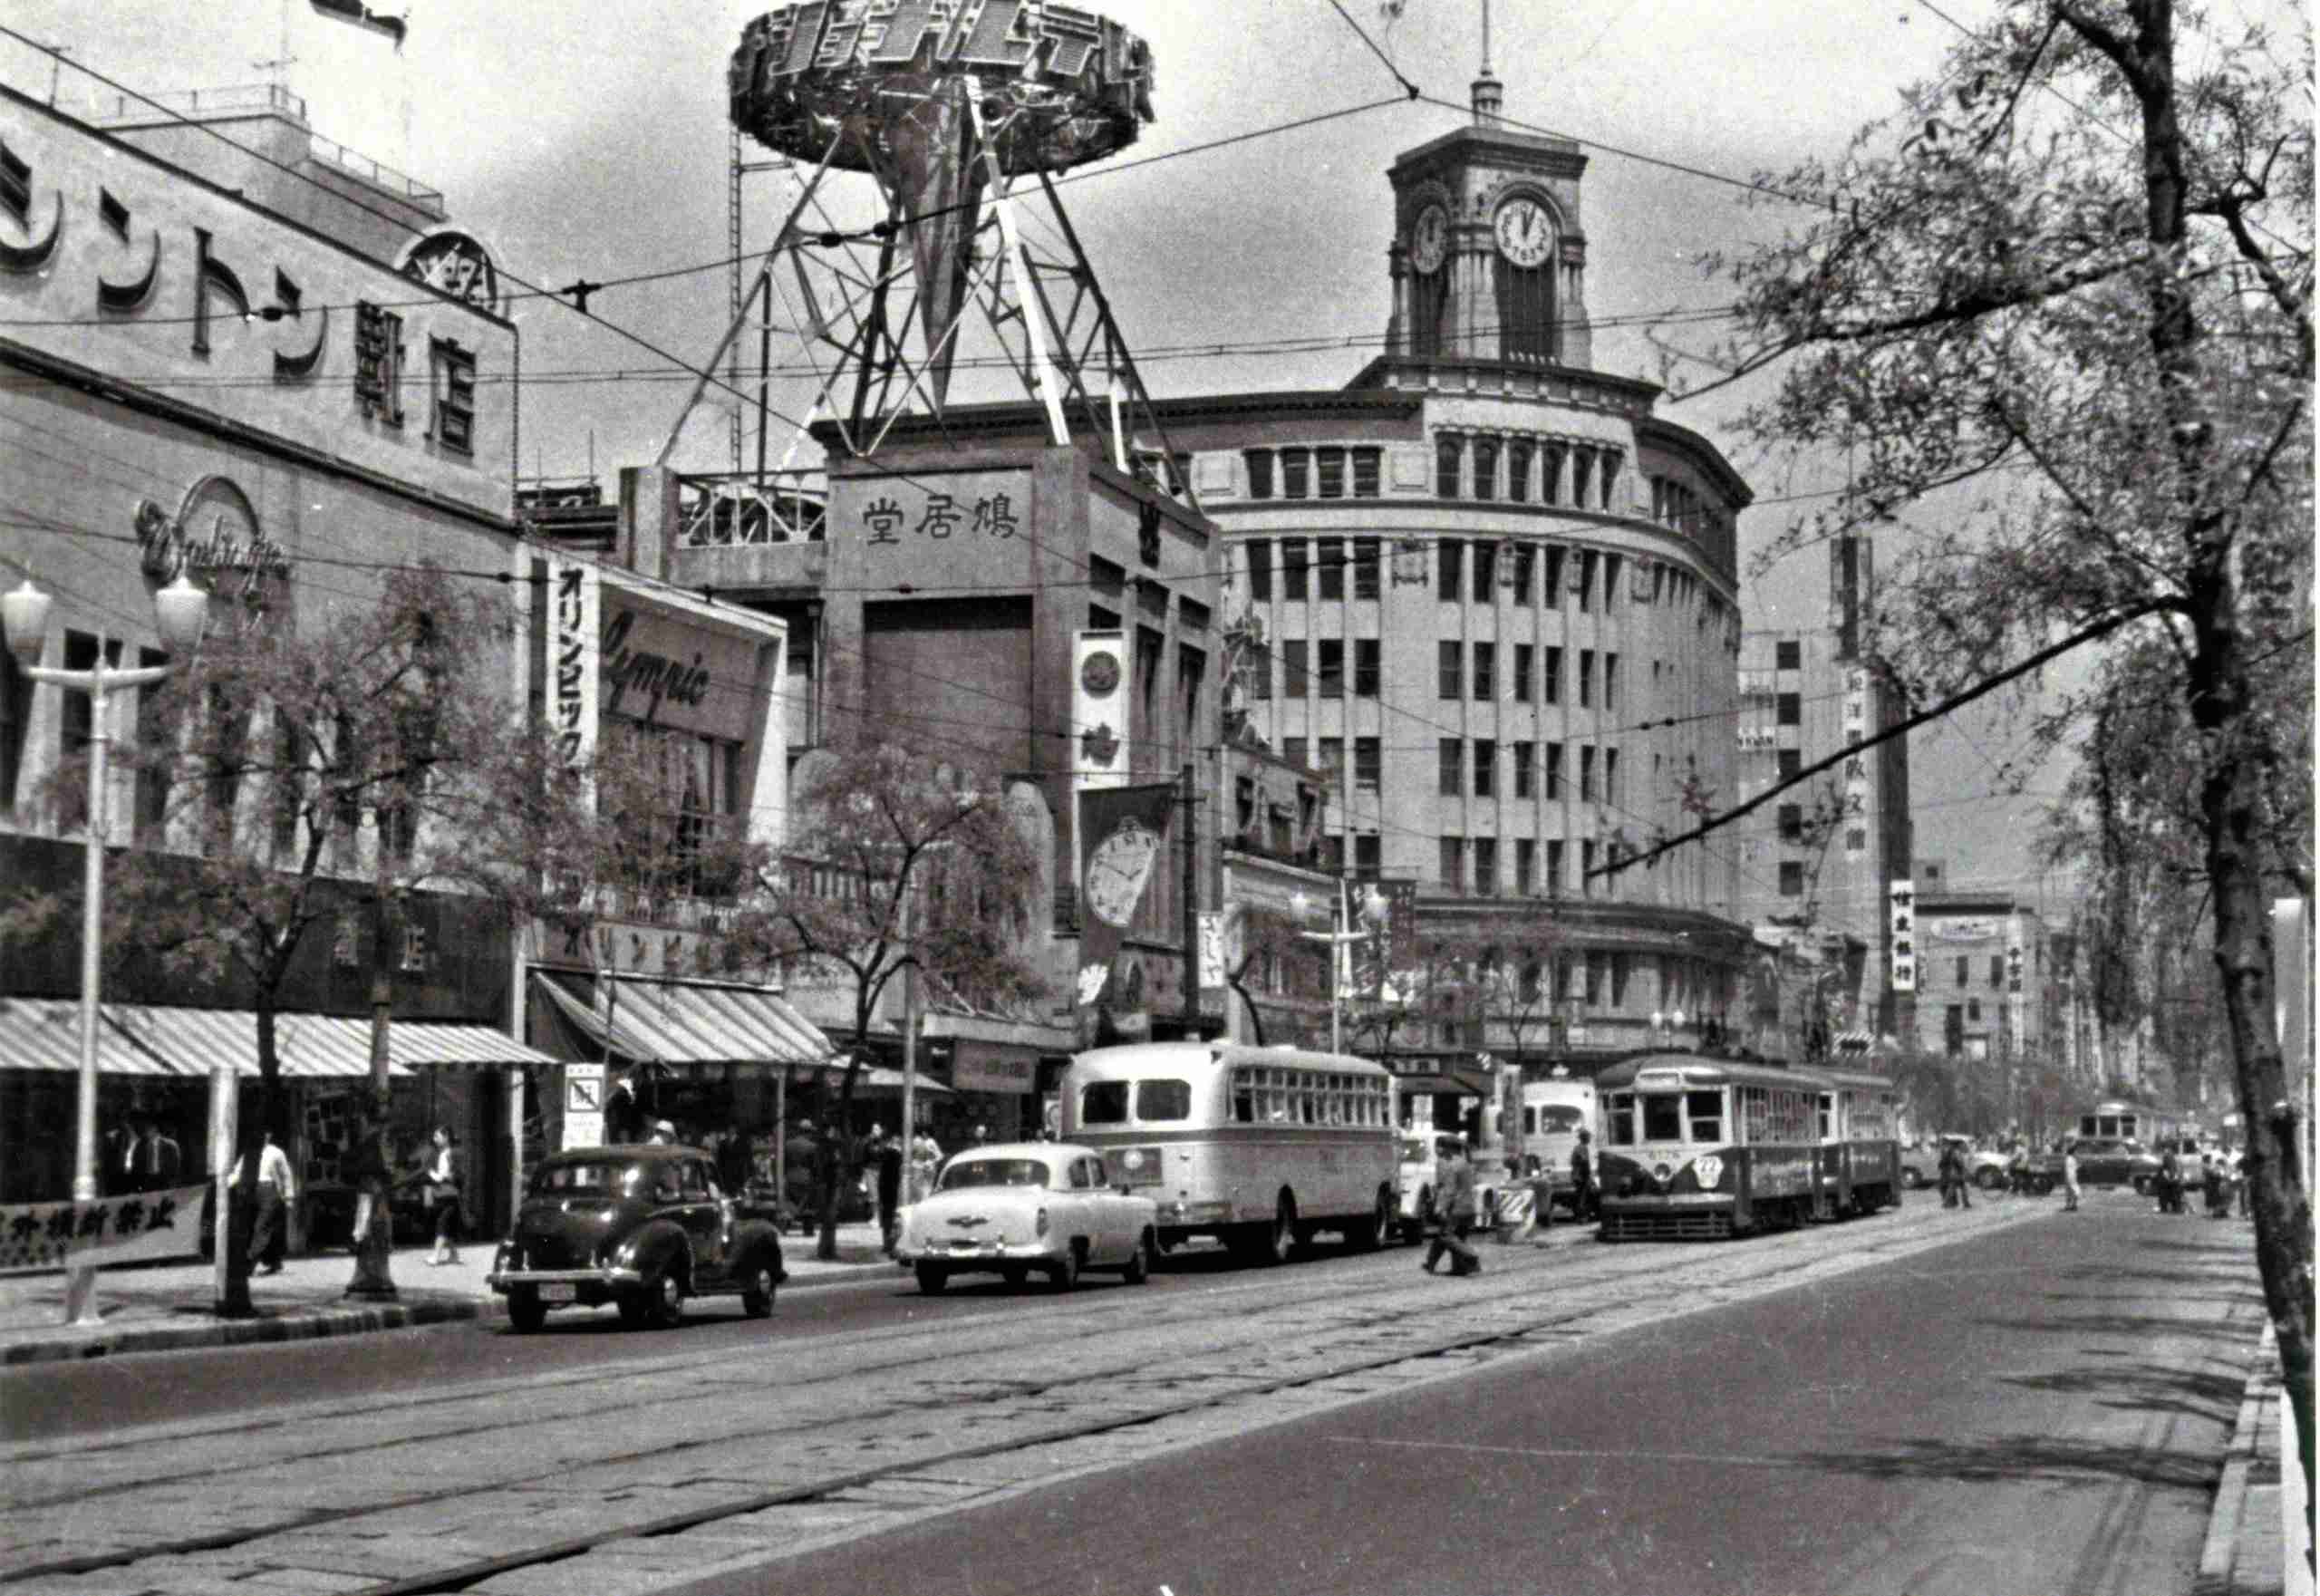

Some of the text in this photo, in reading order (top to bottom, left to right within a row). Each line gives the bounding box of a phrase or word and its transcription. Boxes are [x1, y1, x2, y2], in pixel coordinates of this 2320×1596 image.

[557, 568, 585, 763] オリンピック
